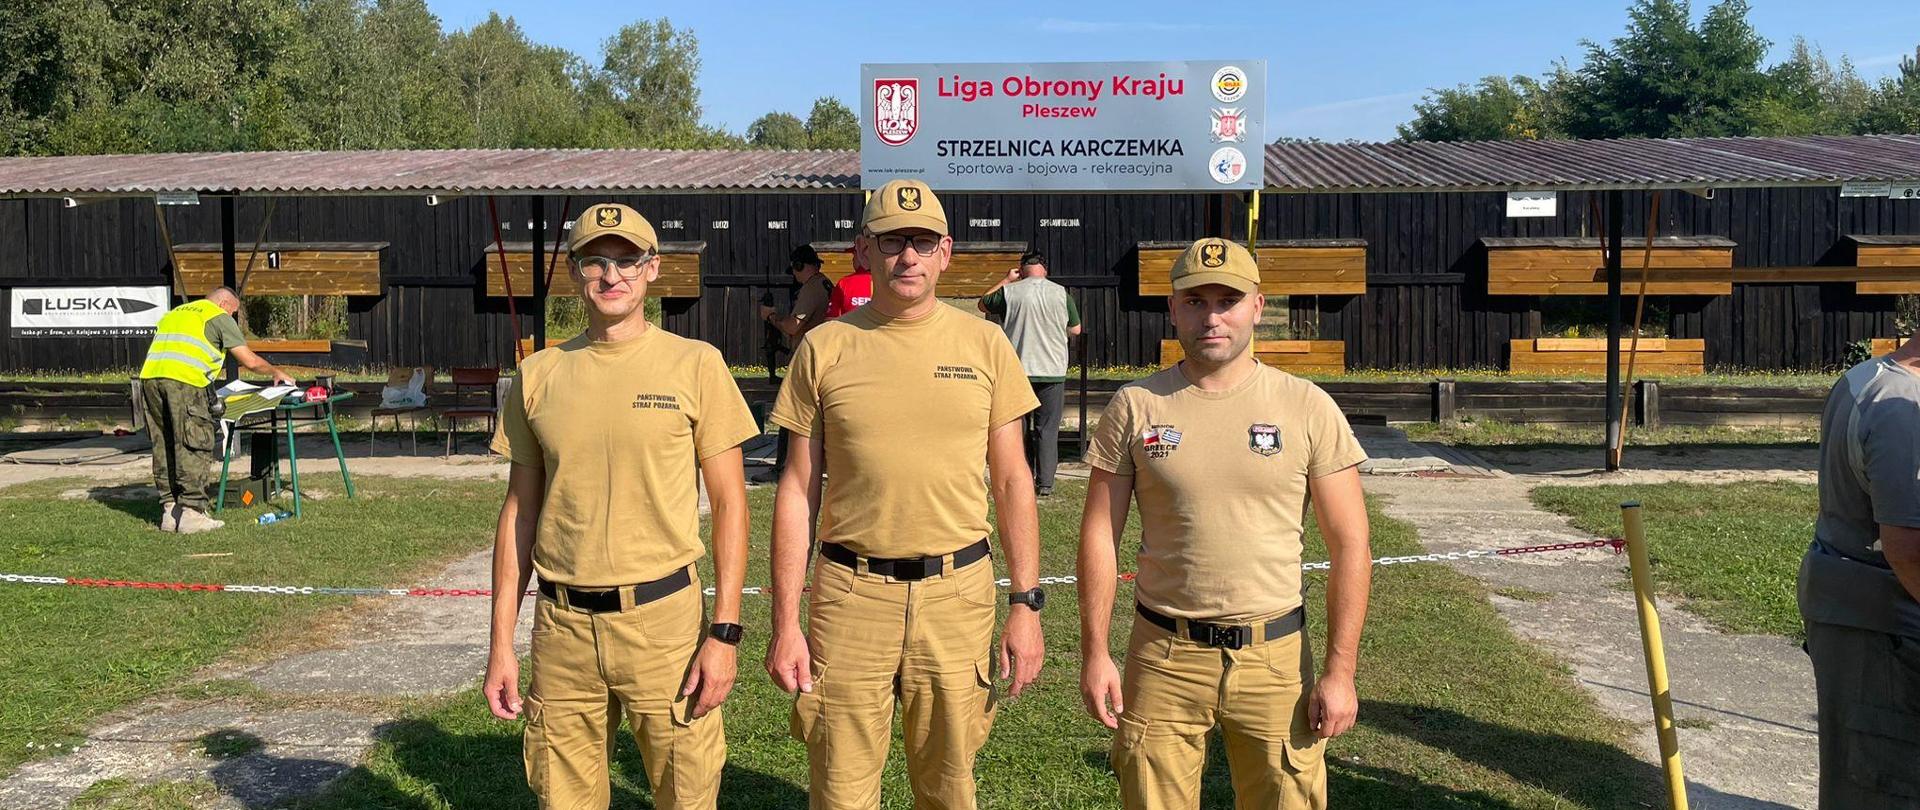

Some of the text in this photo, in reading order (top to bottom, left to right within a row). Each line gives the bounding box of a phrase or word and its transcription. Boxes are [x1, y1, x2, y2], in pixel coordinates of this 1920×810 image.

[937, 73, 1184, 102] Liga Obrony Kraju
[1022, 103, 1097, 118] Pleszew
[882, 119, 908, 130] LOK
[936, 139, 1184, 157] STRZELNICA KARCZEMKA
[947, 162, 1014, 176] Sportowa
[1027, 161, 1078, 176] bojowa
[1091, 161, 1173, 176] rekreacyjna
[712, 220, 729, 229] LUDZI
[768, 220, 788, 229] NAWET
[269, 252, 276, 268] 1
[45, 298, 118, 310] ŁUSKA
[937, 365, 973, 373] PAŃSTWOWA
[636, 393, 676, 402] PAŃSTWOWA
[1150, 451, 1169, 459] 2021
